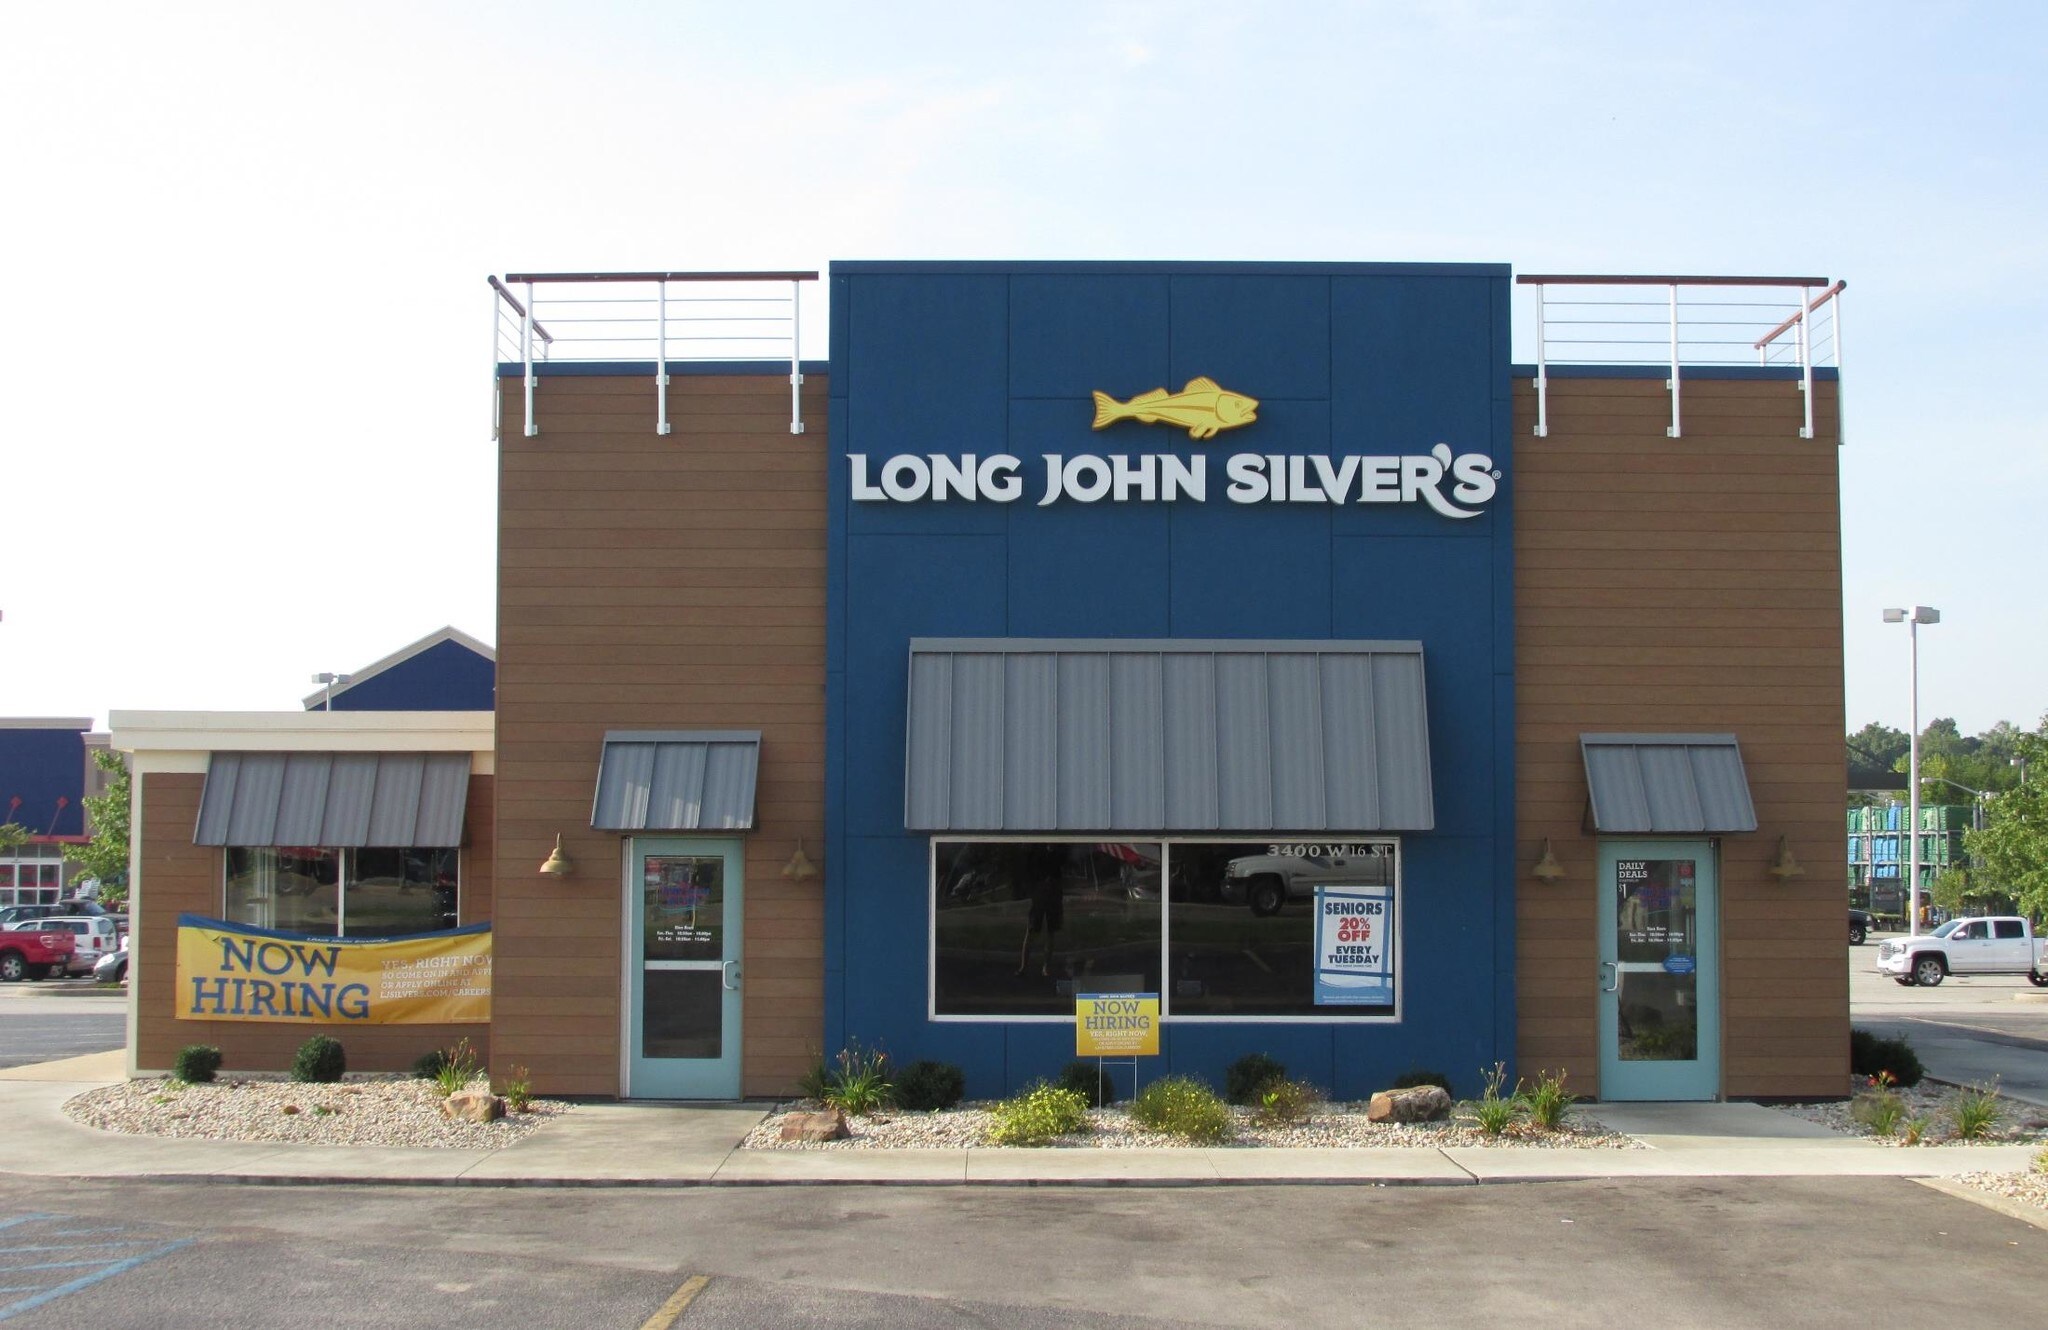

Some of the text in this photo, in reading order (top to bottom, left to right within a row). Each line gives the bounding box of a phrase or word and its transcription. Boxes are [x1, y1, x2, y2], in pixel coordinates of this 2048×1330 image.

[847, 453, 1023, 502] LONG
[1036, 454, 1206, 507] JOHN
[1267, 844, 1392, 857] 3400 W 16 ST
[1618, 862, 1645, 870] DAILY
[1619, 871, 1648, 879] DEALS
[1325, 902, 1382, 915] SENIORS
[1340, 917, 1370, 930] 20%
[1338, 930, 1370, 942] OFF
[1336, 946, 1371, 955] EVERY
[220, 937, 342, 977] NOW
[415, 957, 458, 969] RIGHT
[1328, 955, 1379, 964] TUESDAY
[396, 970, 421, 979] COME
[422, 970, 436, 978] ON
[395, 980, 421, 988] APPLY
[191, 977, 370, 1019] HIRING
[1094, 1001, 1140, 1014] NOW
[1086, 1016, 1149, 1029] HIRING
